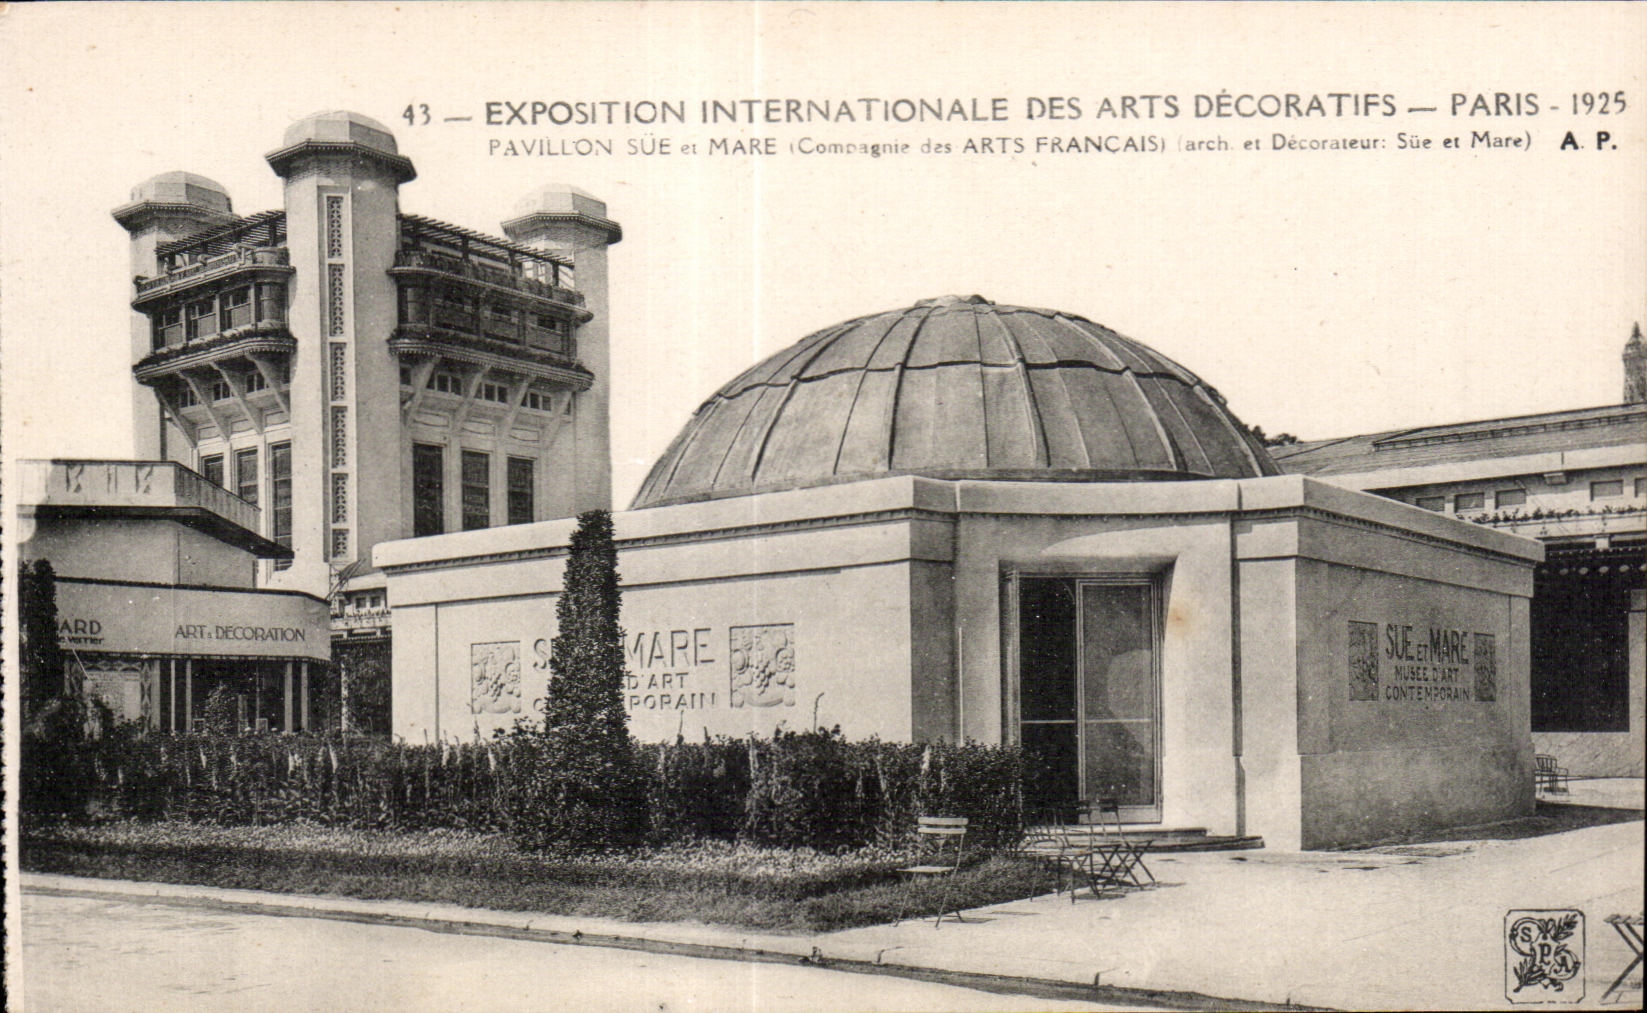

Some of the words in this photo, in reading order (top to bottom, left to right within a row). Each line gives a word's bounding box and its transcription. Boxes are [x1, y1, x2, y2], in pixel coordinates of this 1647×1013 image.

[58, 617, 103, 634] ARD
[174, 624, 208, 639] ART
[622, 627, 716, 670] MARE
[1429, 627, 1470, 665] MARE
[1385, 685, 1471, 701] CONTEMPORAIN
